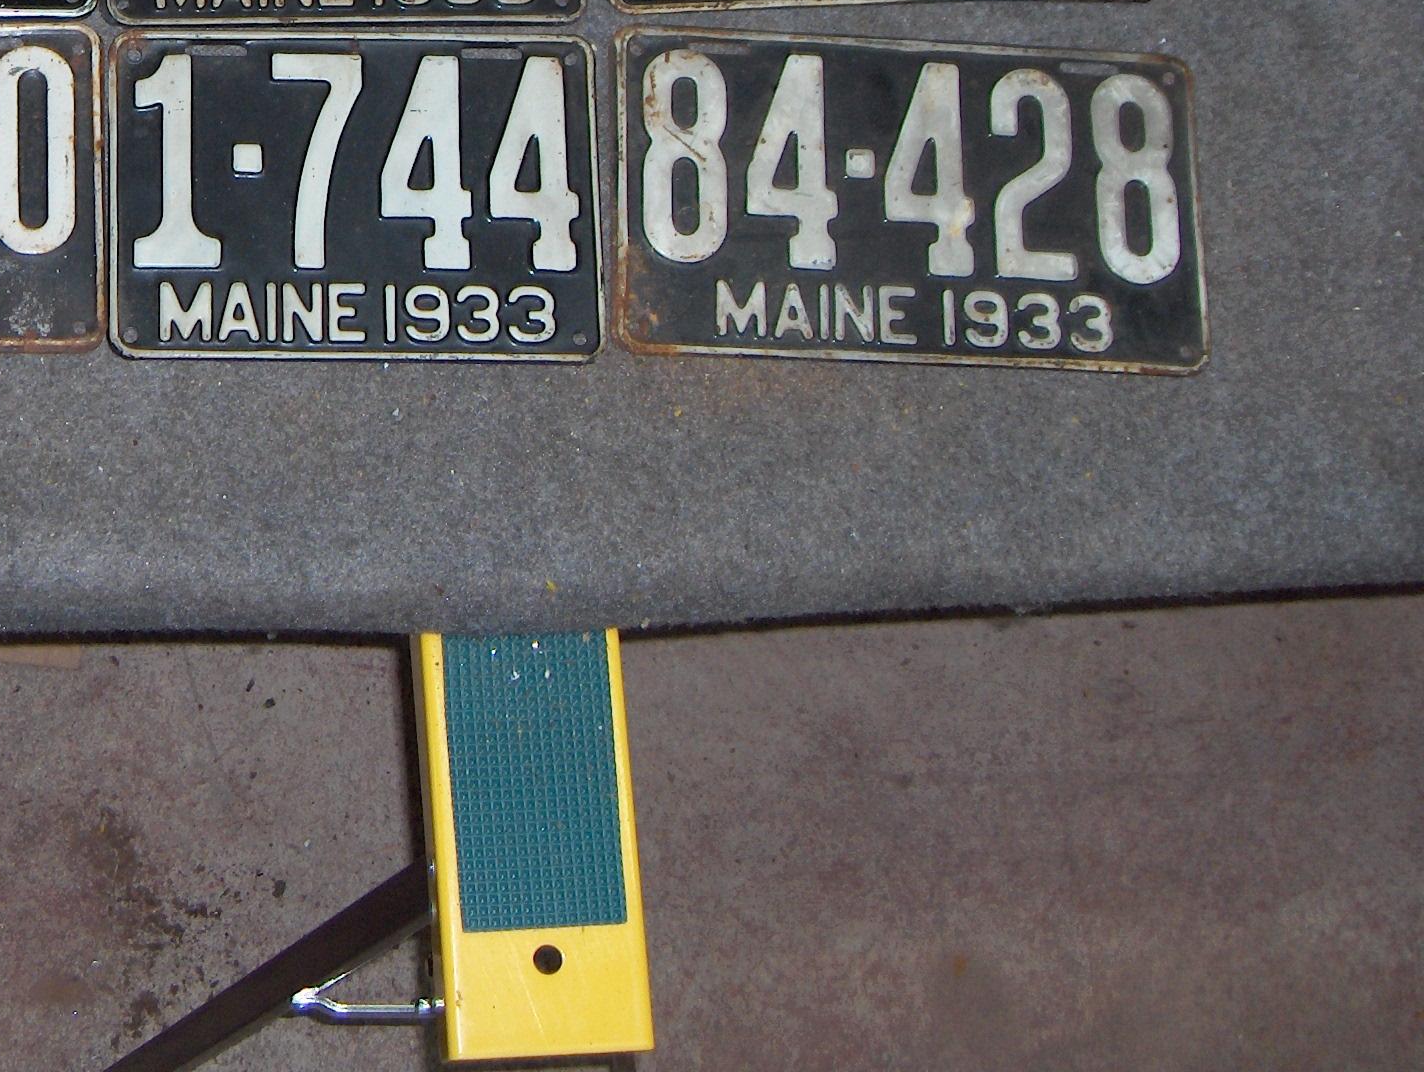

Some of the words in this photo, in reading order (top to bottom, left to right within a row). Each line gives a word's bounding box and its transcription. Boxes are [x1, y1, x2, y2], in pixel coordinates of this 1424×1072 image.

[159, 281, 367, 343] MAINE
[384, 284, 556, 344] 1933
[716, 280, 918, 345] MAINE
[943, 288, 1115, 353] 1933
